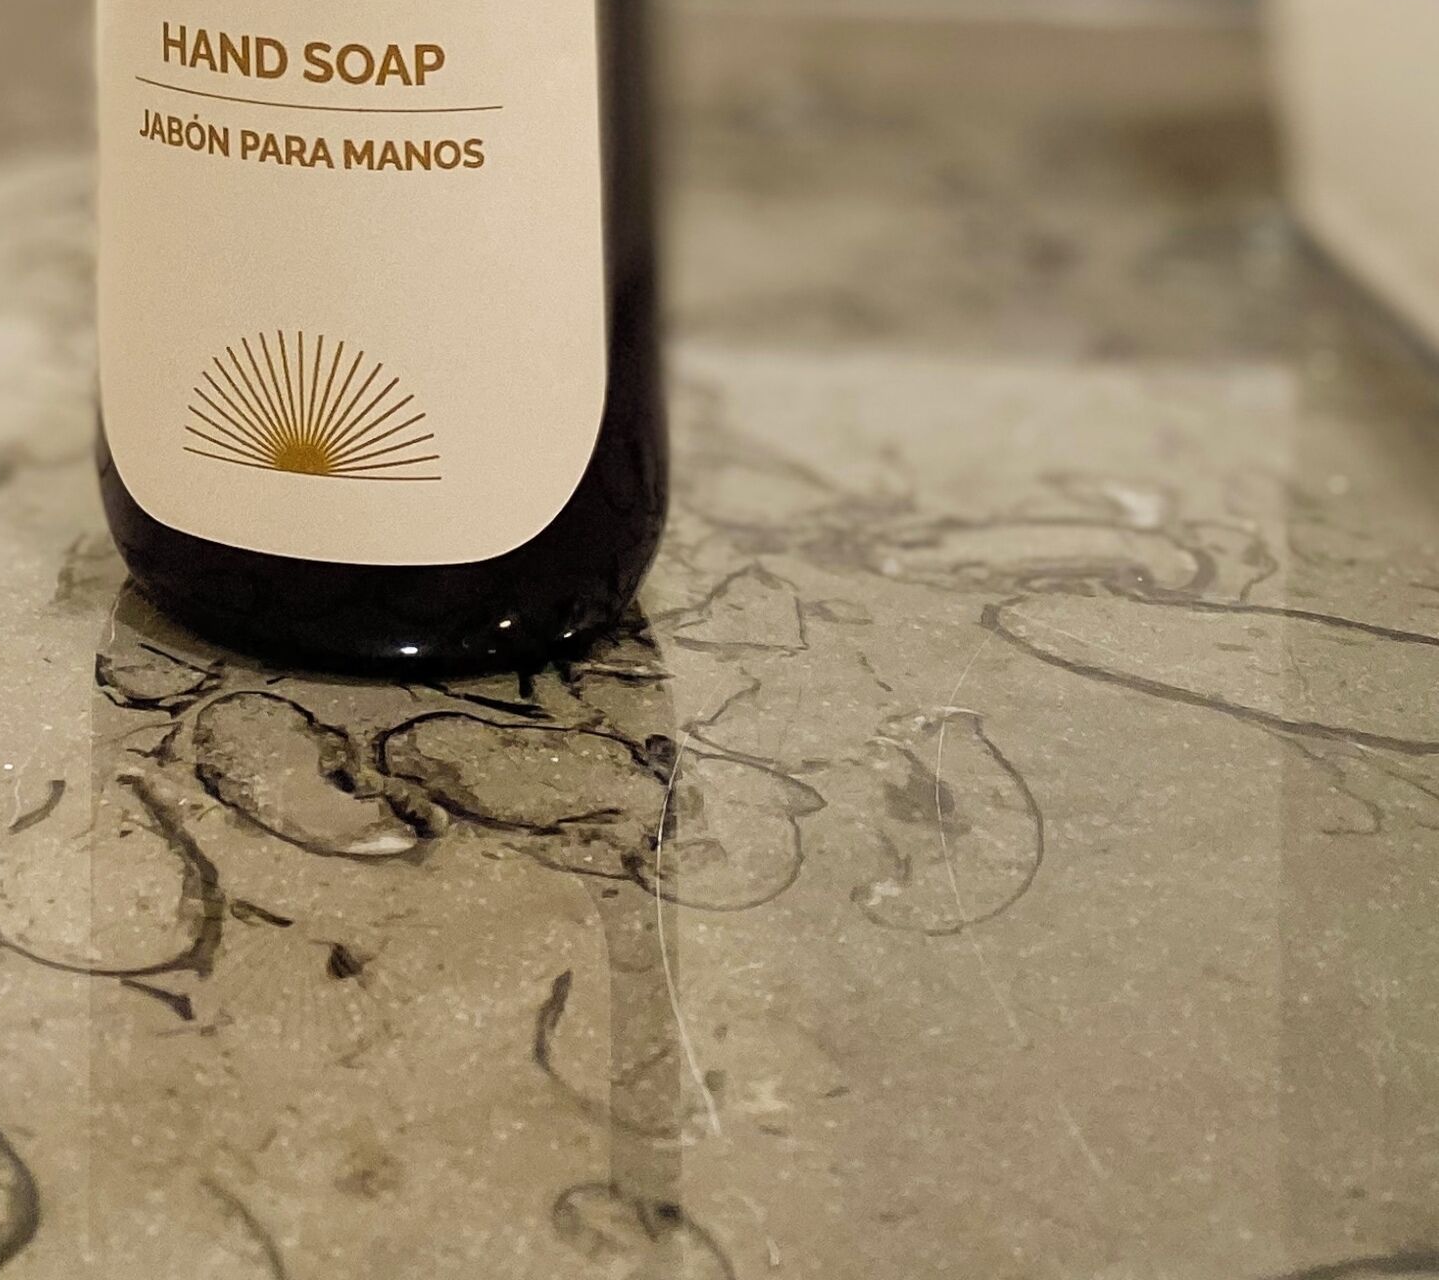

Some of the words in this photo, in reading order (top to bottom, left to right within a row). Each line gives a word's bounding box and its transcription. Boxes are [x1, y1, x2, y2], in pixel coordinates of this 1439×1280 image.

[162, 21, 289, 80] HAND
[302, 41, 446, 87] SOAP
[139, 108, 230, 158] JABÓN
[240, 129, 336, 170] PARA
[342, 137, 485, 172] MANOS
